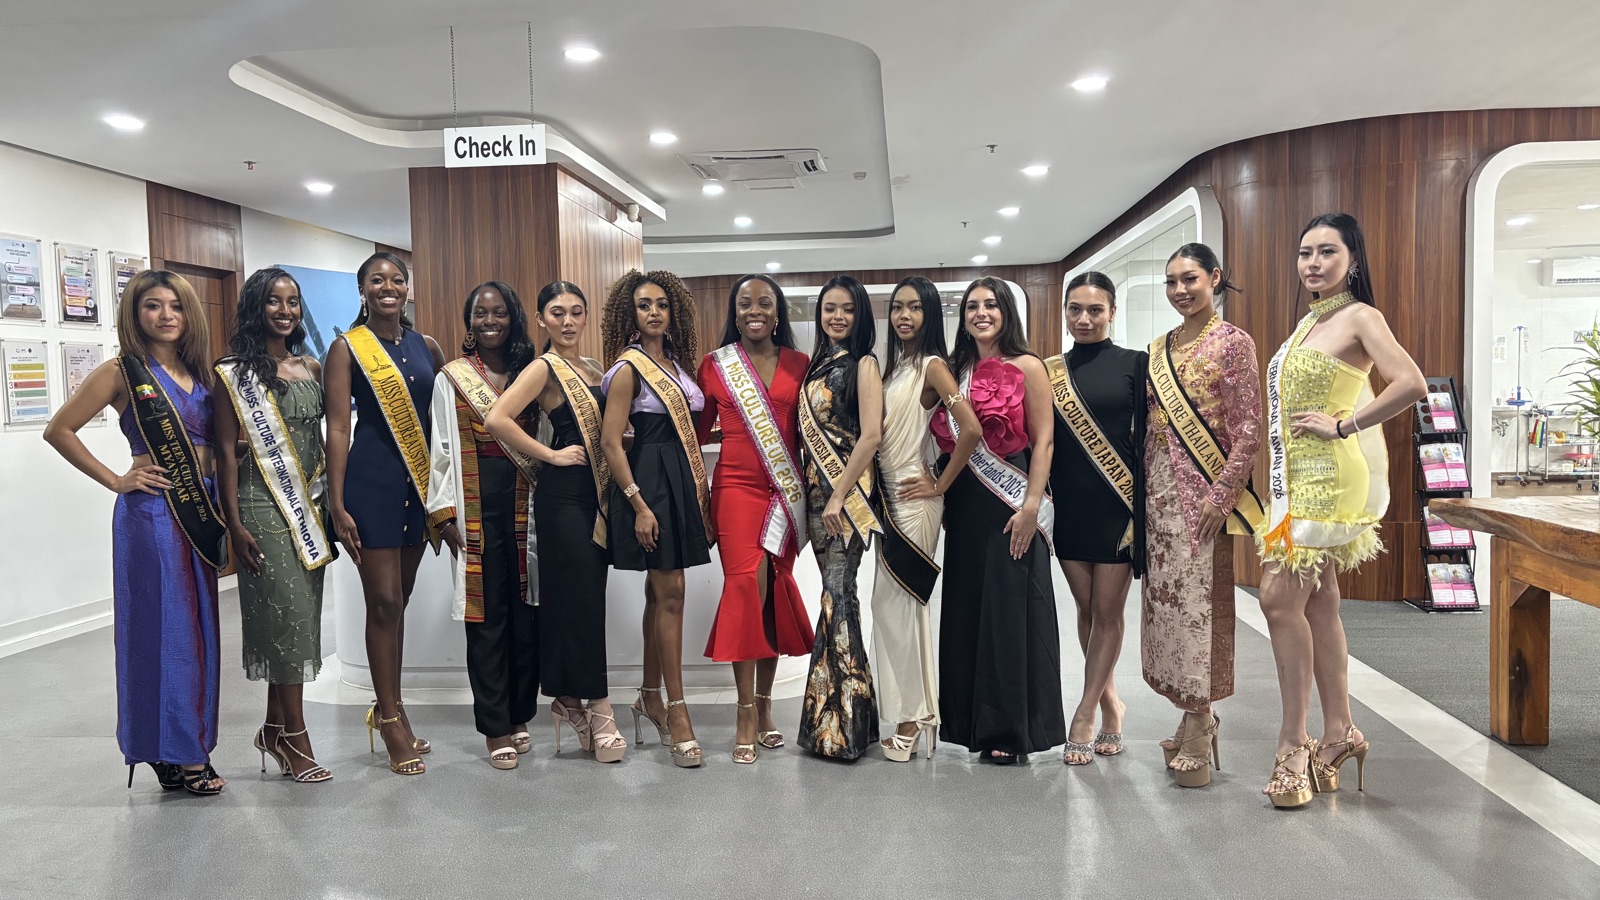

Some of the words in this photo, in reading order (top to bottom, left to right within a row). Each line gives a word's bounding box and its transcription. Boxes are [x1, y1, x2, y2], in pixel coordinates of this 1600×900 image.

[454, 134, 514, 159] Check
[519, 133, 536, 156] In
[378, 374, 402, 400] MISS
[565, 377, 582, 391] MISS
[655, 378, 673, 392] MISS
[725, 360, 750, 389] MISS
[476, 389, 492, 406] MISS
[571, 388, 590, 404] TEEN
[665, 388, 686, 417] CULTURE
[388, 398, 417, 442] CULTURE
[578, 401, 599, 429] CULTURE
[739, 387, 779, 448] CULTURE
[1156, 373, 1189, 423] CULTURE
[1181, 419, 1224, 476] THAILAND
[678, 412, 697, 459] INTERNATIONAL
[804, 421, 828, 463] INDONESIA
[824, 459, 843, 479] 2026
[1051, 378, 1071, 403] MISS
[1062, 400, 1102, 451] CULTURE
[1094, 446, 1127, 484] JAPAN
[1118, 480, 1134, 505] 202
[1270, 428, 1284, 471] TAIWAN
[159, 418, 177, 441] MISS
[170, 438, 188, 465] TEEN
[180, 463, 202, 503] CULTURE
[196, 502, 210, 522] 2026
[686, 455, 705, 482] CANADA
[767, 444, 787, 469] UK
[158, 444, 190, 503] MYANMAR
[243, 387, 259, 409] MISS
[251, 410, 277, 447] CULTURE
[267, 447, 301, 509] INTERNATIONAL
[293, 504, 320, 561] ETHIOPIA
[775, 467, 802, 504] 2026
[999, 474, 1027, 499] 2026
[1272, 473, 1285, 500] 2026
